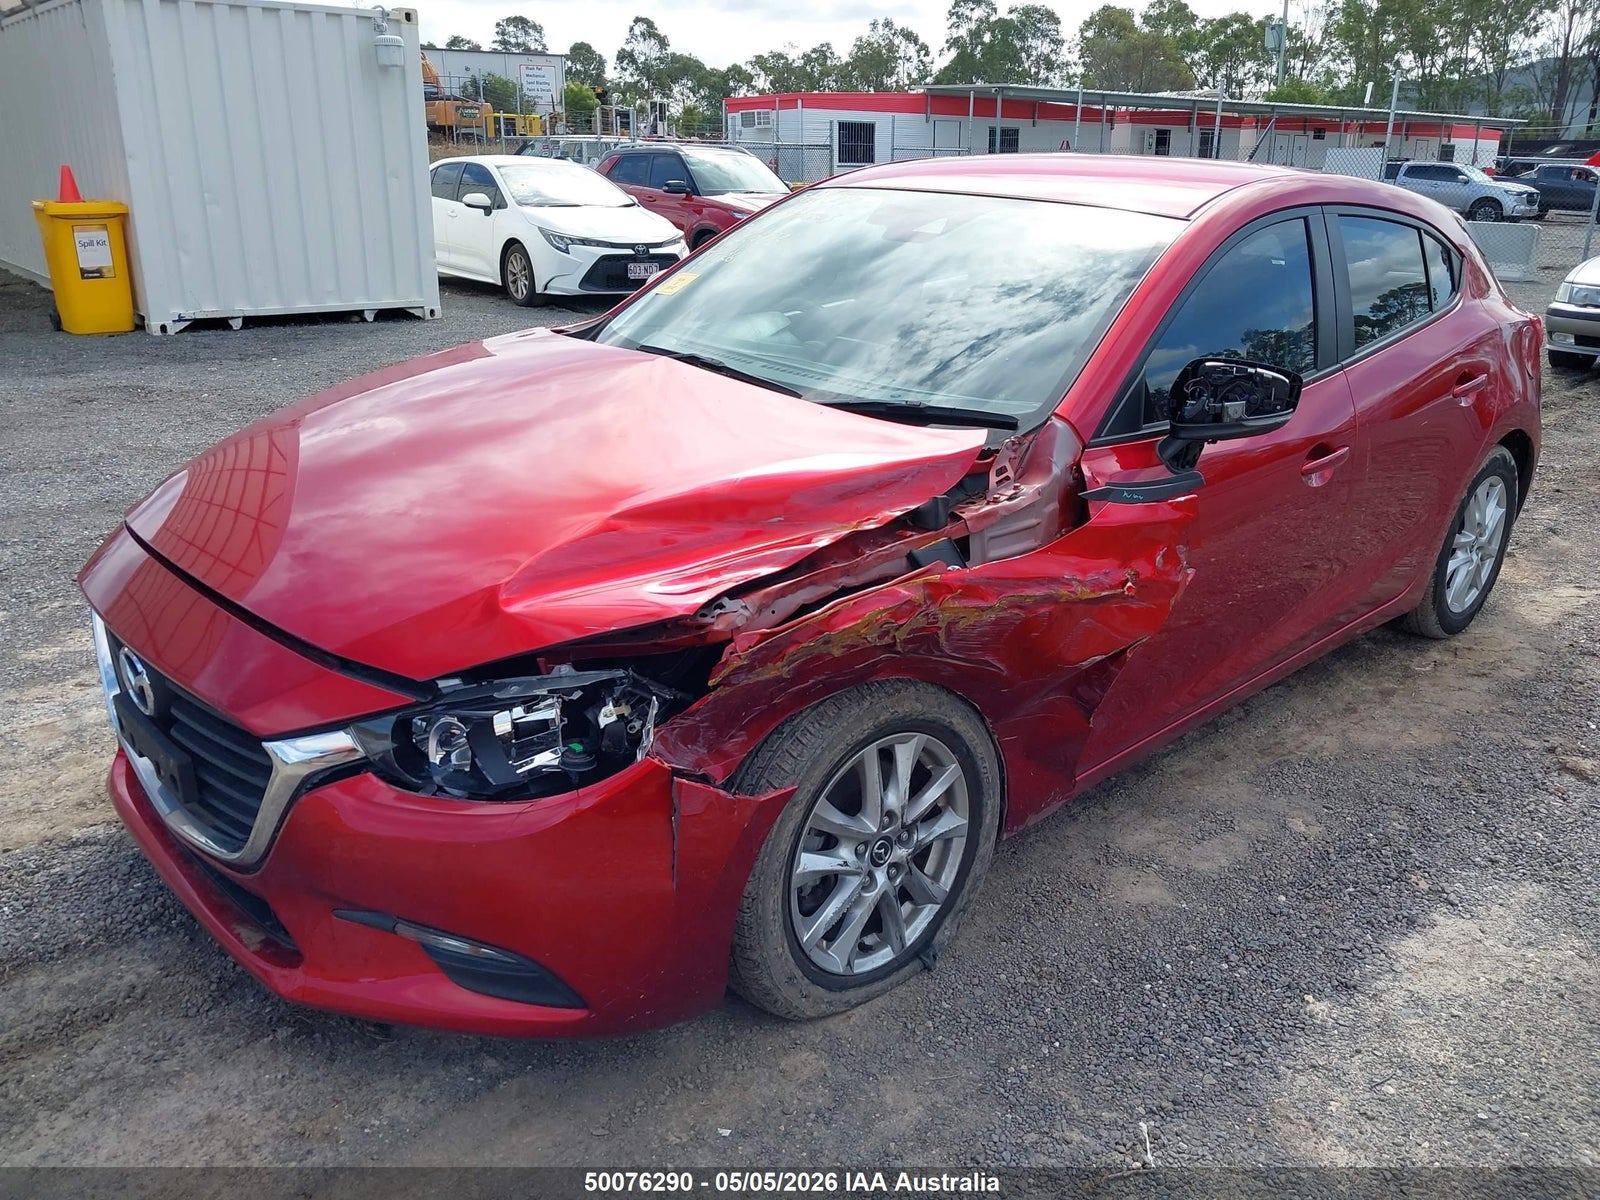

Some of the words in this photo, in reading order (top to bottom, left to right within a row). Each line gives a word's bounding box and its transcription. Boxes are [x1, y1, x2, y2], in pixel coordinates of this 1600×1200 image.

[78, 240, 95, 249] Spill
[96, 239, 108, 247] Kit
[629, 265, 642, 275] 603
